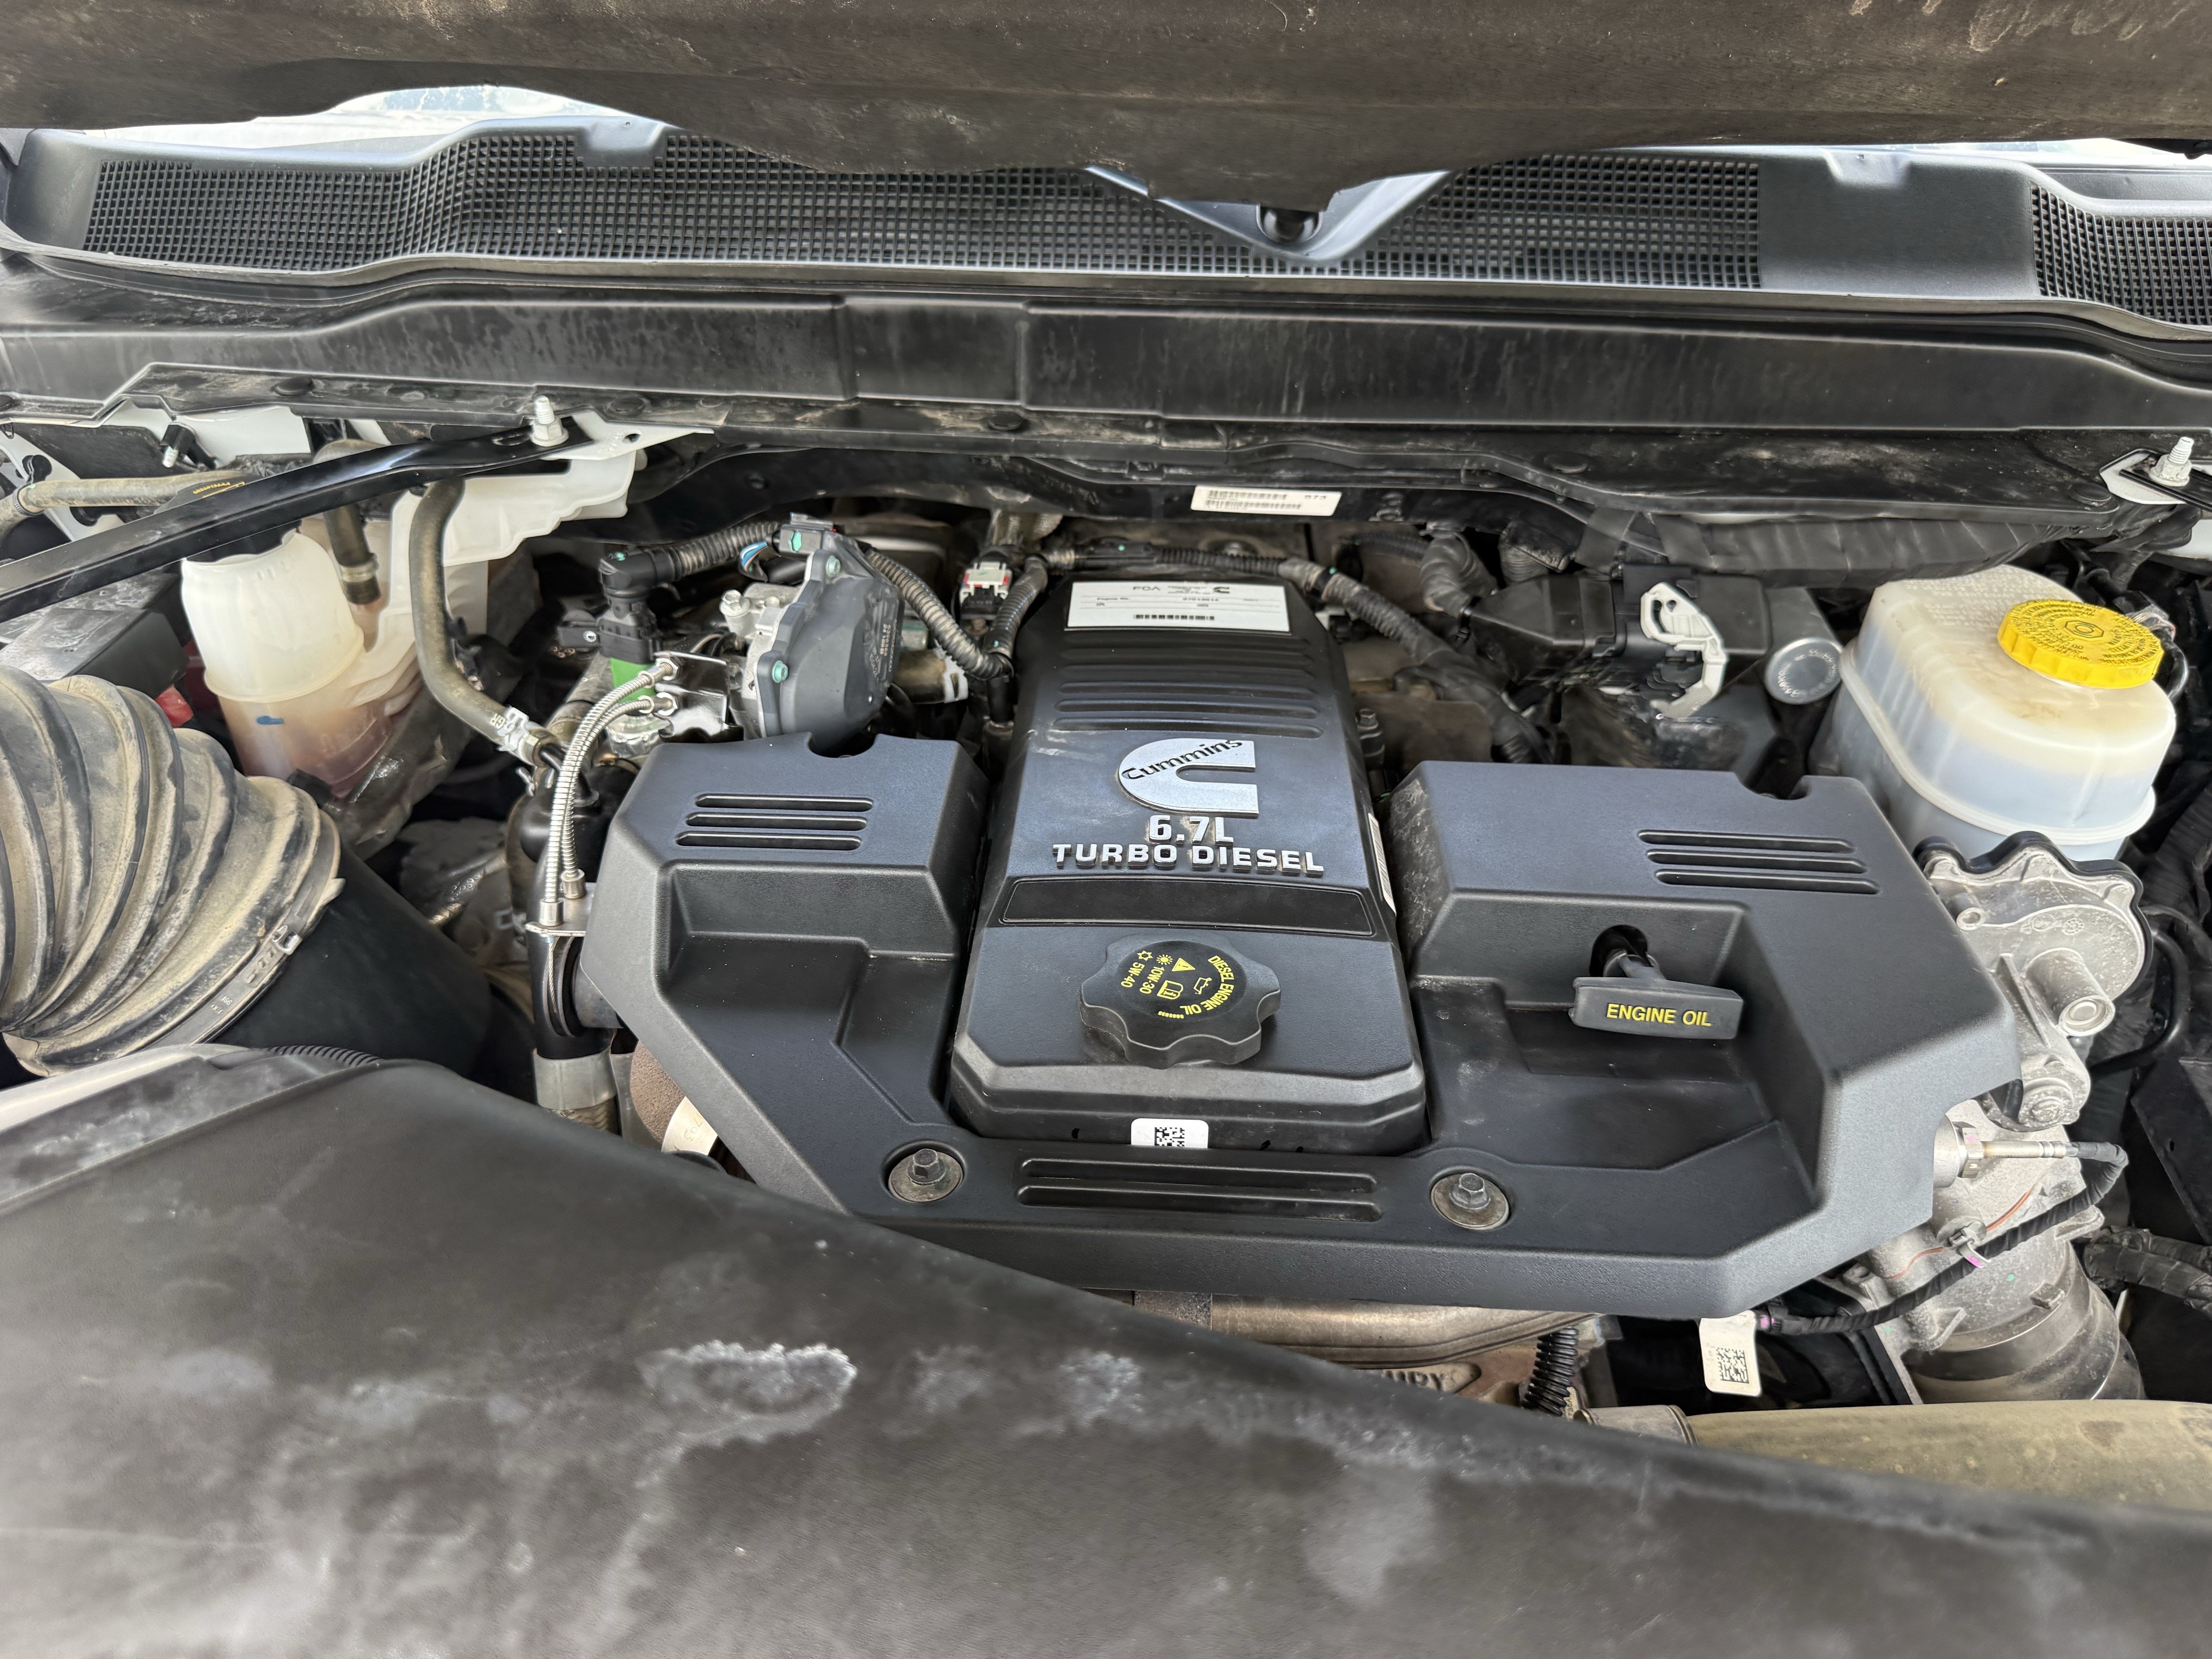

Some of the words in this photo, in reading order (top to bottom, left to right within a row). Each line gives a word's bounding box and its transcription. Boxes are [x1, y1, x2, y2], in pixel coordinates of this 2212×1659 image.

[1121, 739, 1243, 780] Cummins
[1148, 815, 1234, 846] 6.7L
[1053, 844, 1178, 868] TURBO
[1192, 845, 1324, 875] DIESEL
[1121, 961, 1145, 988] 5W-40
[1139, 967, 1165, 994] 10W-30
[1207, 955, 1235, 983] DIESEL
[1180, 1004, 1202, 1015] OIL
[1200, 982, 1234, 1011] ENGINE
[1606, 1003, 1677, 1024] ENGINE
[1682, 1010, 1712, 1027] OIL
